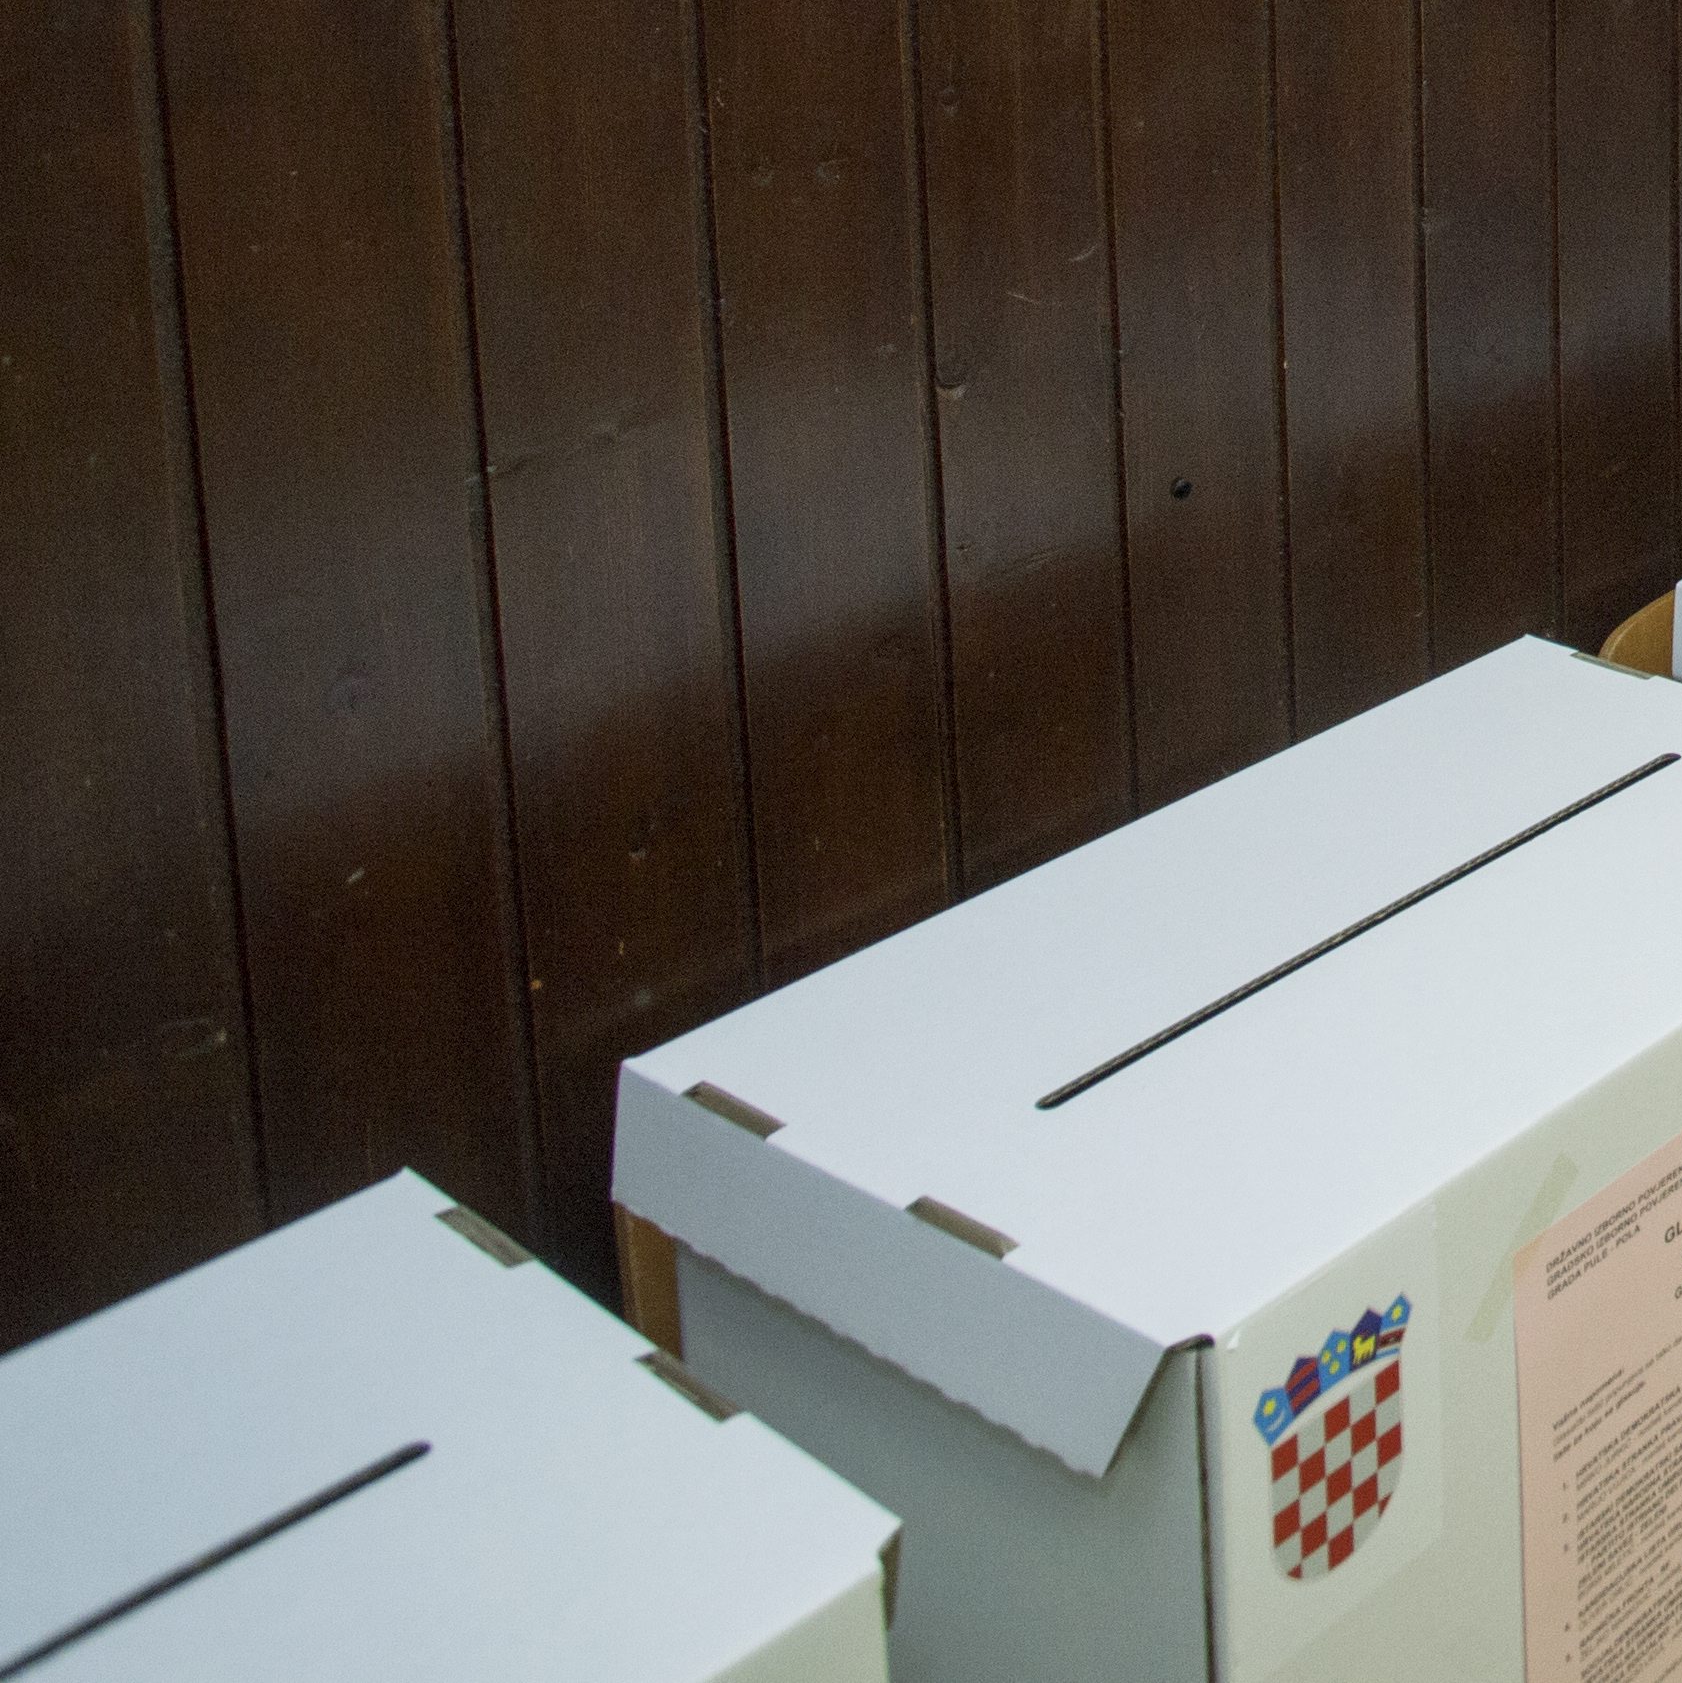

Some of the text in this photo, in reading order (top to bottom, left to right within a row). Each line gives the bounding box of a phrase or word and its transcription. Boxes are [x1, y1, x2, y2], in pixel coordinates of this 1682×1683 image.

[1545, 1232, 1592, 1273] DRŽAVNO
[1593, 1199, 1636, 1237] IZBORNO
[1546, 1244, 1594, 1286] GRADSKO
[1595, 1211, 1638, 1249] IZBORNO
[1547, 1267, 1581, 1299] GRADA
[1583, 1248, 1607, 1272] PULE
[1615, 1222, 1641, 1248] POLA
